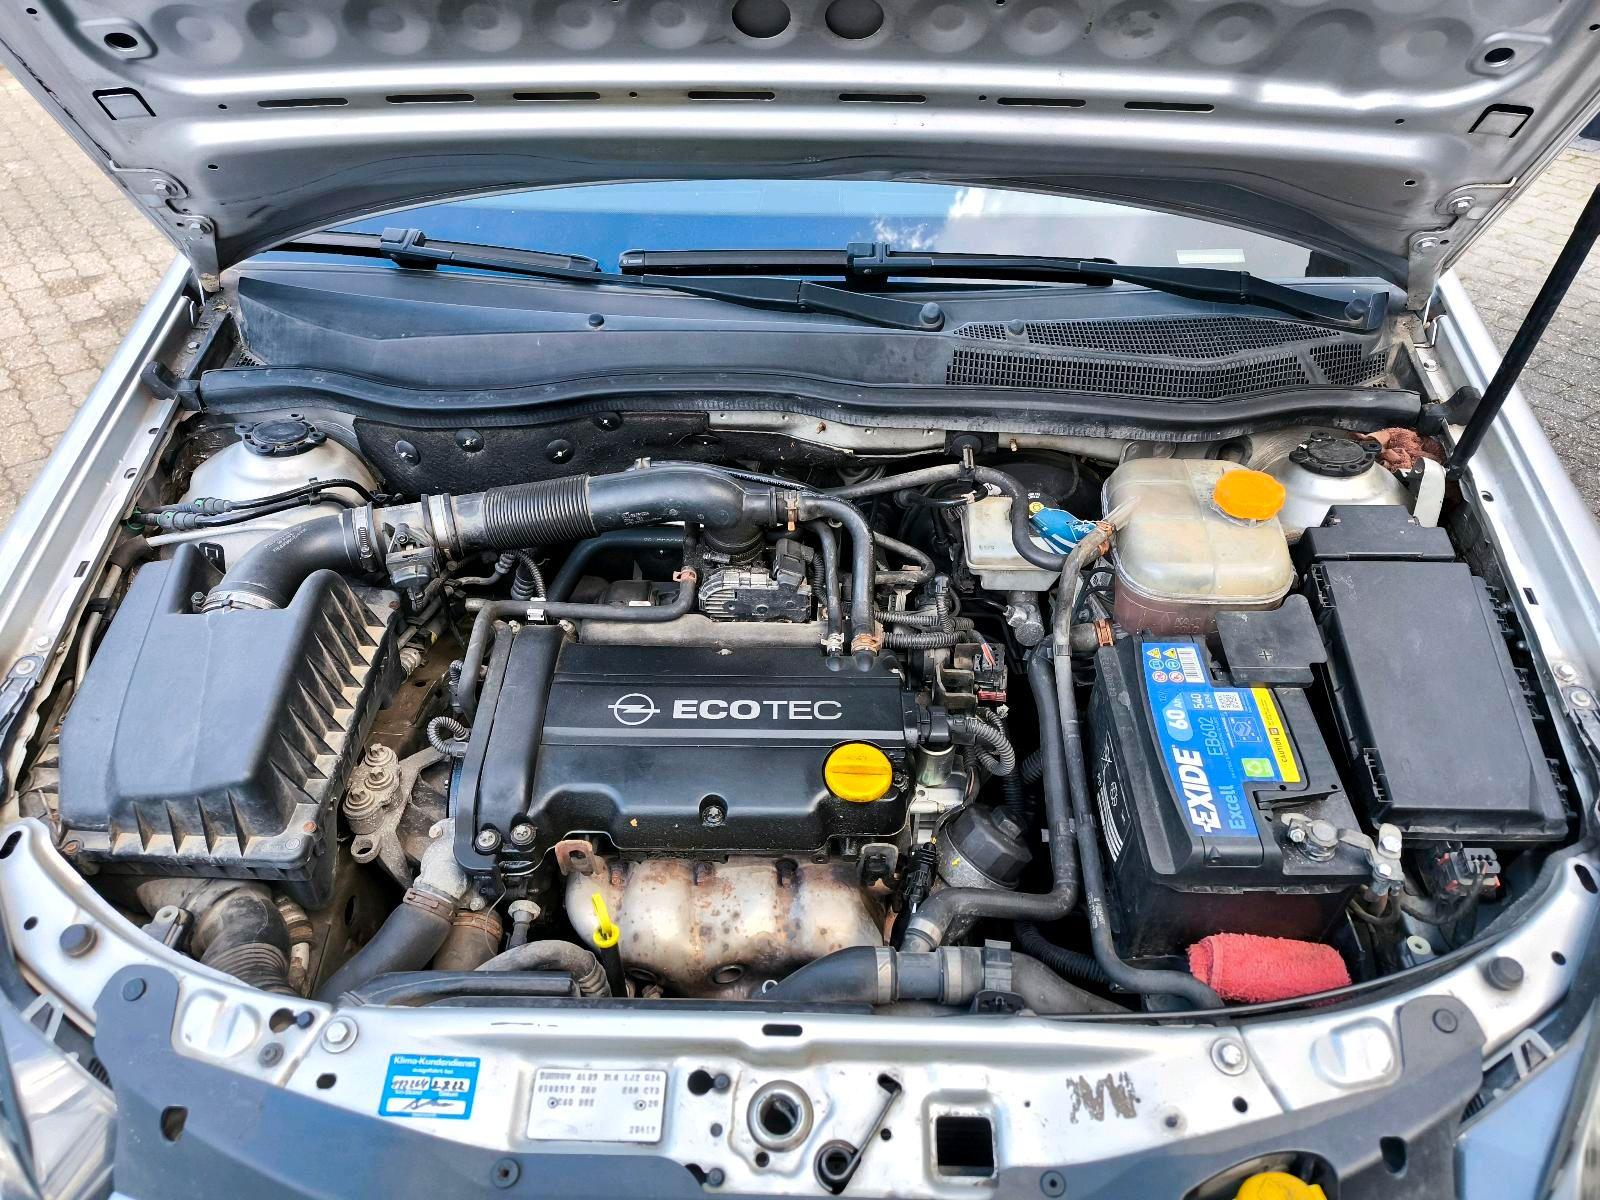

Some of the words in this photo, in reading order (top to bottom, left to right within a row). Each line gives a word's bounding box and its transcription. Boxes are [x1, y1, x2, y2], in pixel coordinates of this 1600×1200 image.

[672, 699, 843, 720] ECOTEC
[1190, 693, 1205, 709] 540
[1166, 709, 1189, 730] 60
[1199, 716, 1224, 756] EB602
[1273, 737, 1289, 764] CAUTION
[1173, 746, 1221, 833] EXIDE
[1218, 784, 1247, 830] Excell
[393, 1056, 477, 1068] Klima-Kundendienst
